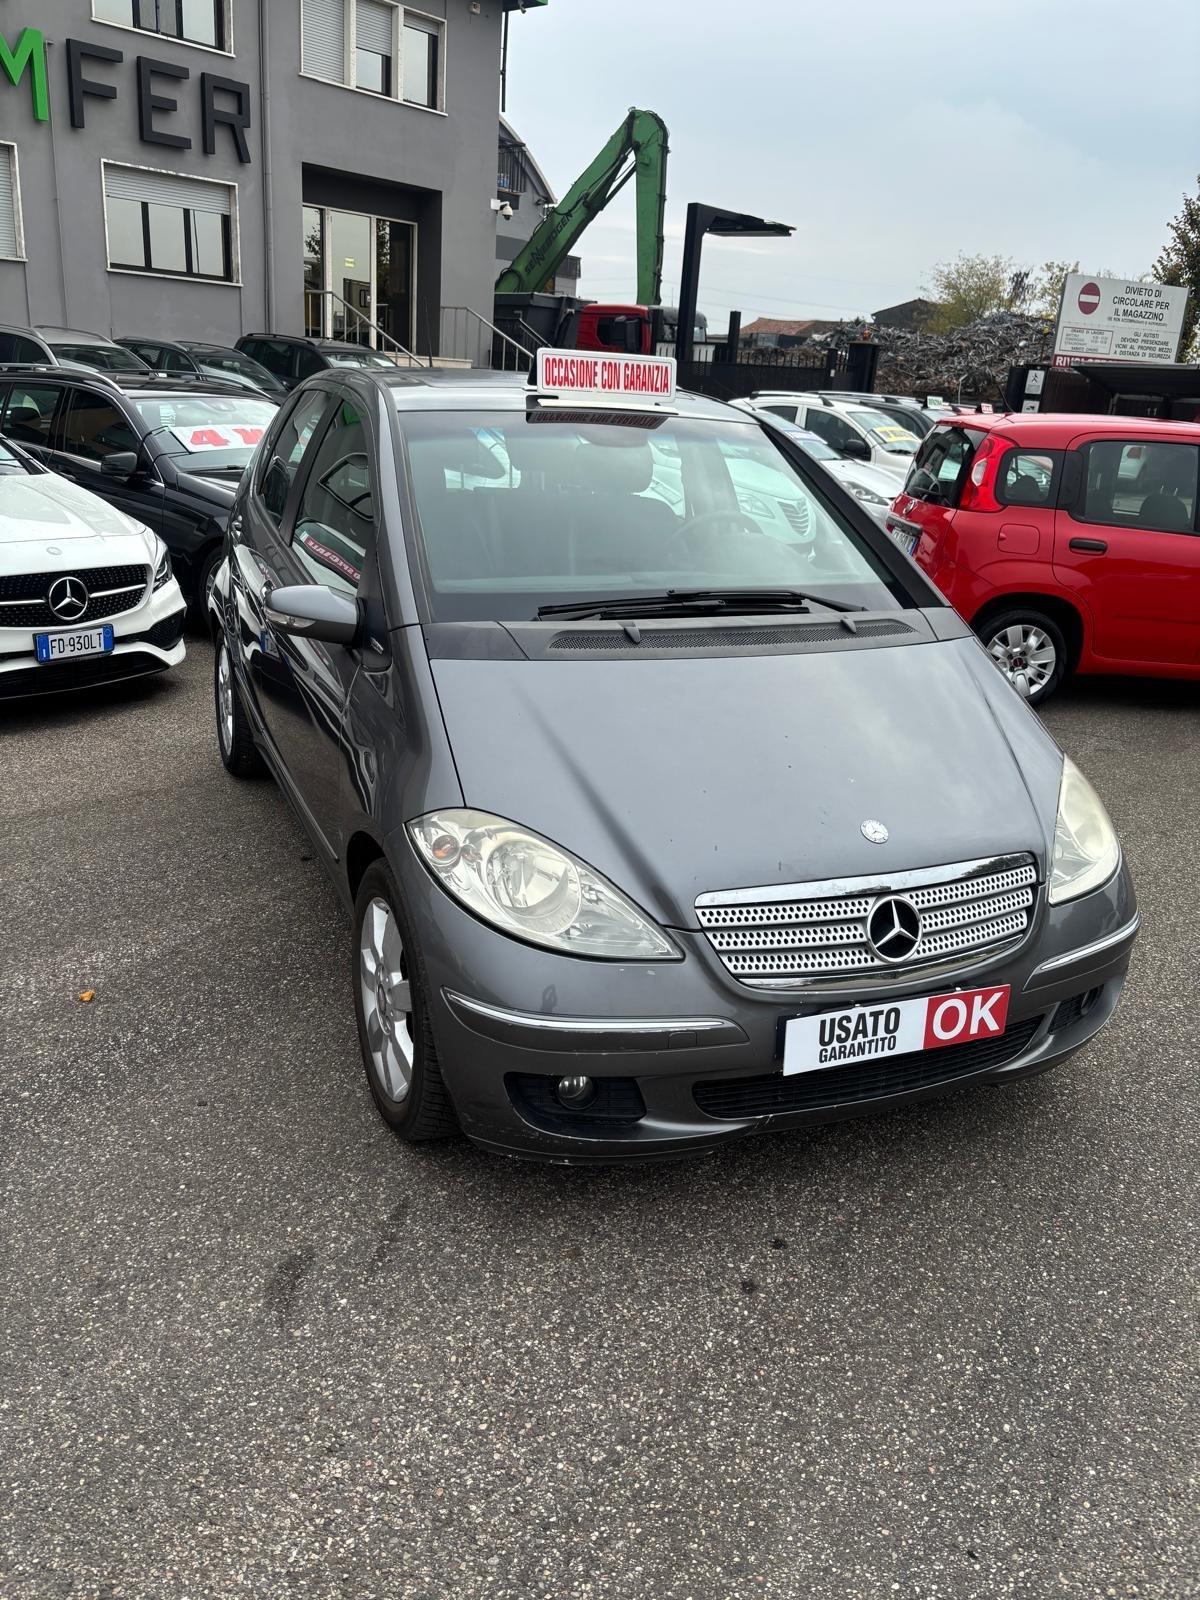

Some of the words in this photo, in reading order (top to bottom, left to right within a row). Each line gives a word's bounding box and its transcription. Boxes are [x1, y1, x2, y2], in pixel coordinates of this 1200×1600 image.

[1112, 296, 1154, 308] CIRCOLARE
[1155, 301, 1170, 310] PER
[1125, 286, 1153, 297] DIVIETO
[1154, 290, 1162, 298] DI
[1113, 308, 1120, 316] IL
[1122, 309, 1164, 321] MAGAZZINO
[544, 357, 598, 389] OCCASIONE
[601, 361, 621, 390] CON
[623, 363, 669, 393] GARANZIA
[819, 1007, 901, 1047] USATO
[932, 991, 1004, 1040] OK
[818, 1034, 897, 1064] GARANTITO
